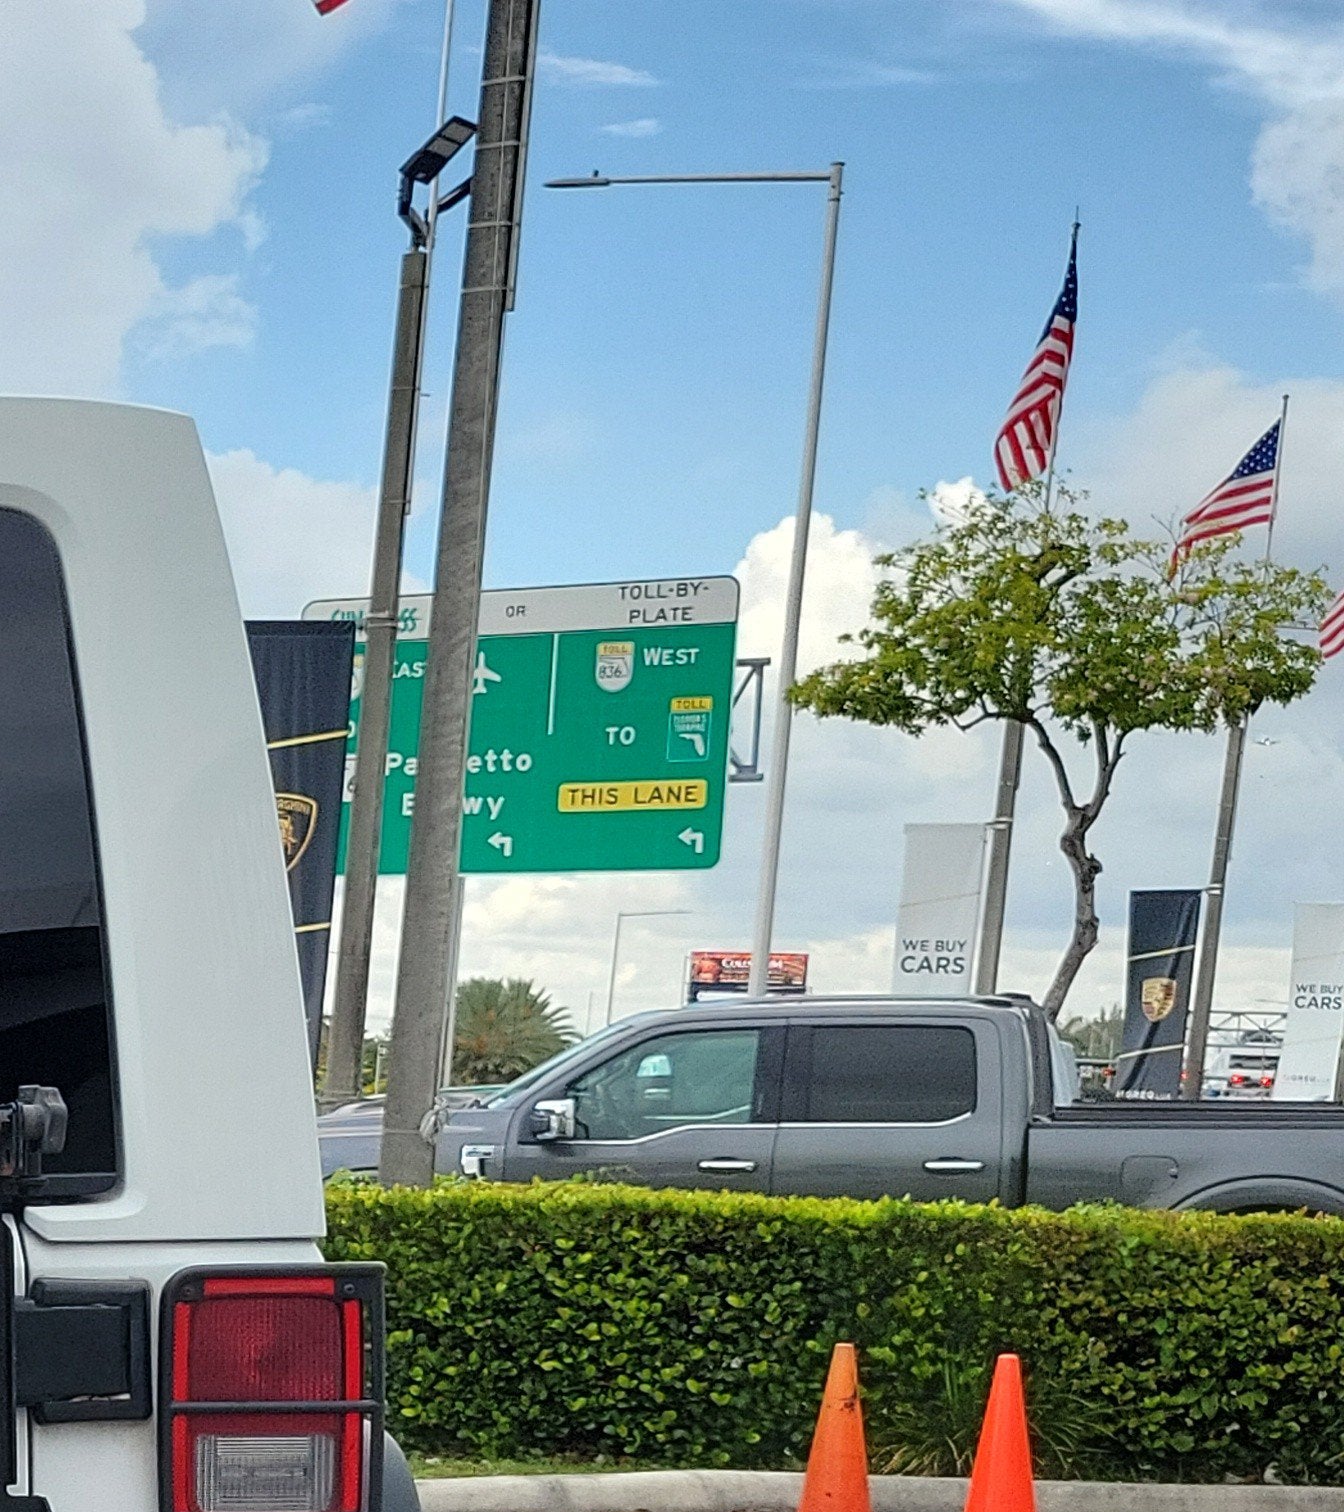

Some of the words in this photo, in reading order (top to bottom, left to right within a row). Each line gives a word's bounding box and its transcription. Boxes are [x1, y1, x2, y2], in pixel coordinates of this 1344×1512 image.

[505, 604, 526, 618] OR
[629, 606, 695, 624] PLATE
[643, 647, 701, 666] WEST
[675, 699, 708, 710] TOLL
[605, 725, 636, 746] TO
[384, 749, 533, 777] Paetto
[567, 788, 619, 806] THIS
[633, 785, 699, 805] LANE
[401, 792, 505, 821] Ewy
[901, 939, 930, 953] WE
[934, 939, 967, 953] BUY
[900, 955, 965, 974] CARS
[1295, 983, 1317, 994] WE
[1320, 984, 1343, 994] BUY
[1294, 995, 1342, 1010] CARS
